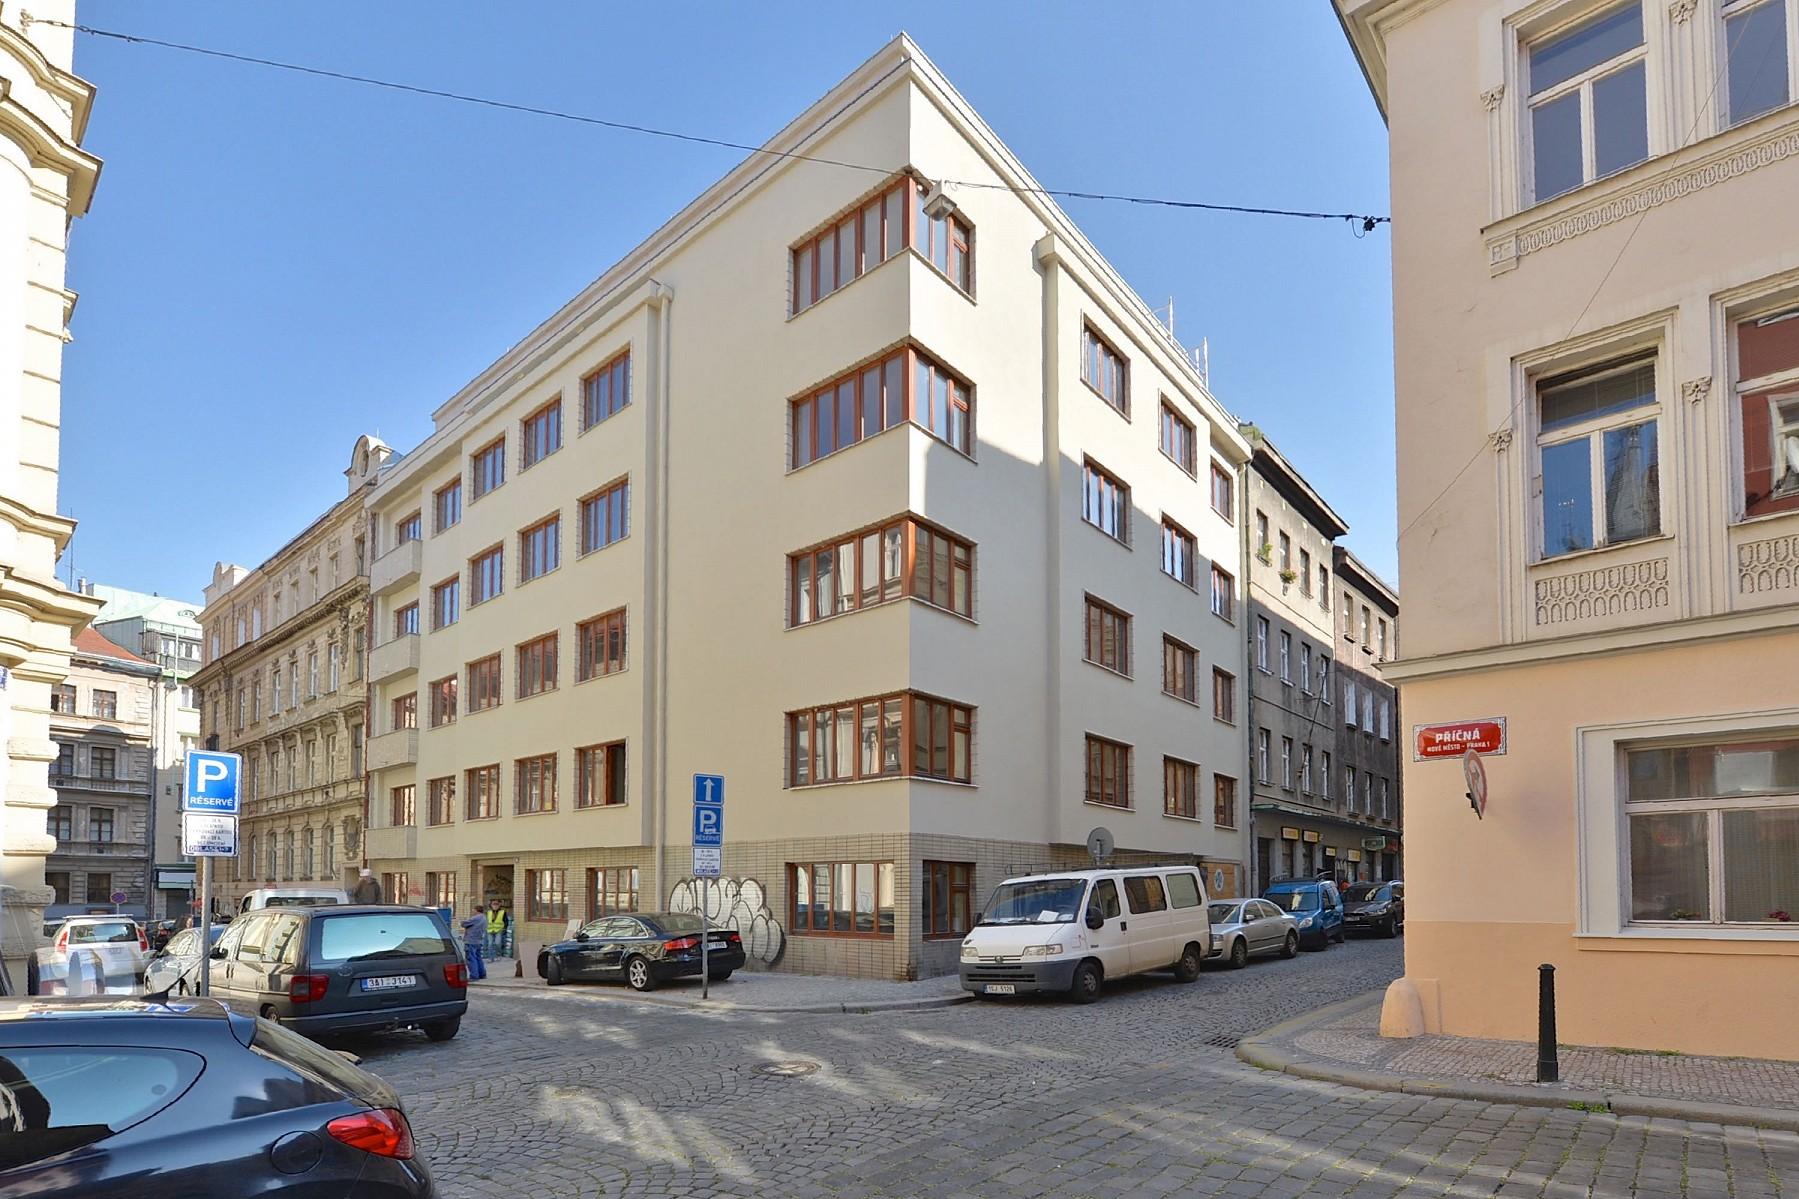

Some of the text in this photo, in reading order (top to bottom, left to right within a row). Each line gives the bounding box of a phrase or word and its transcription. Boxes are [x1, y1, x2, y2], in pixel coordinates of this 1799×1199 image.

[1435, 728, 1480, 743] PŘÍČNÁ
[1427, 744, 1442, 752] NOVÉ
[1443, 743, 1460, 751] MĚSTO
[197, 758, 228, 792] P
[190, 795, 233, 807] RÉSERVÉ
[700, 810, 717, 832] P
